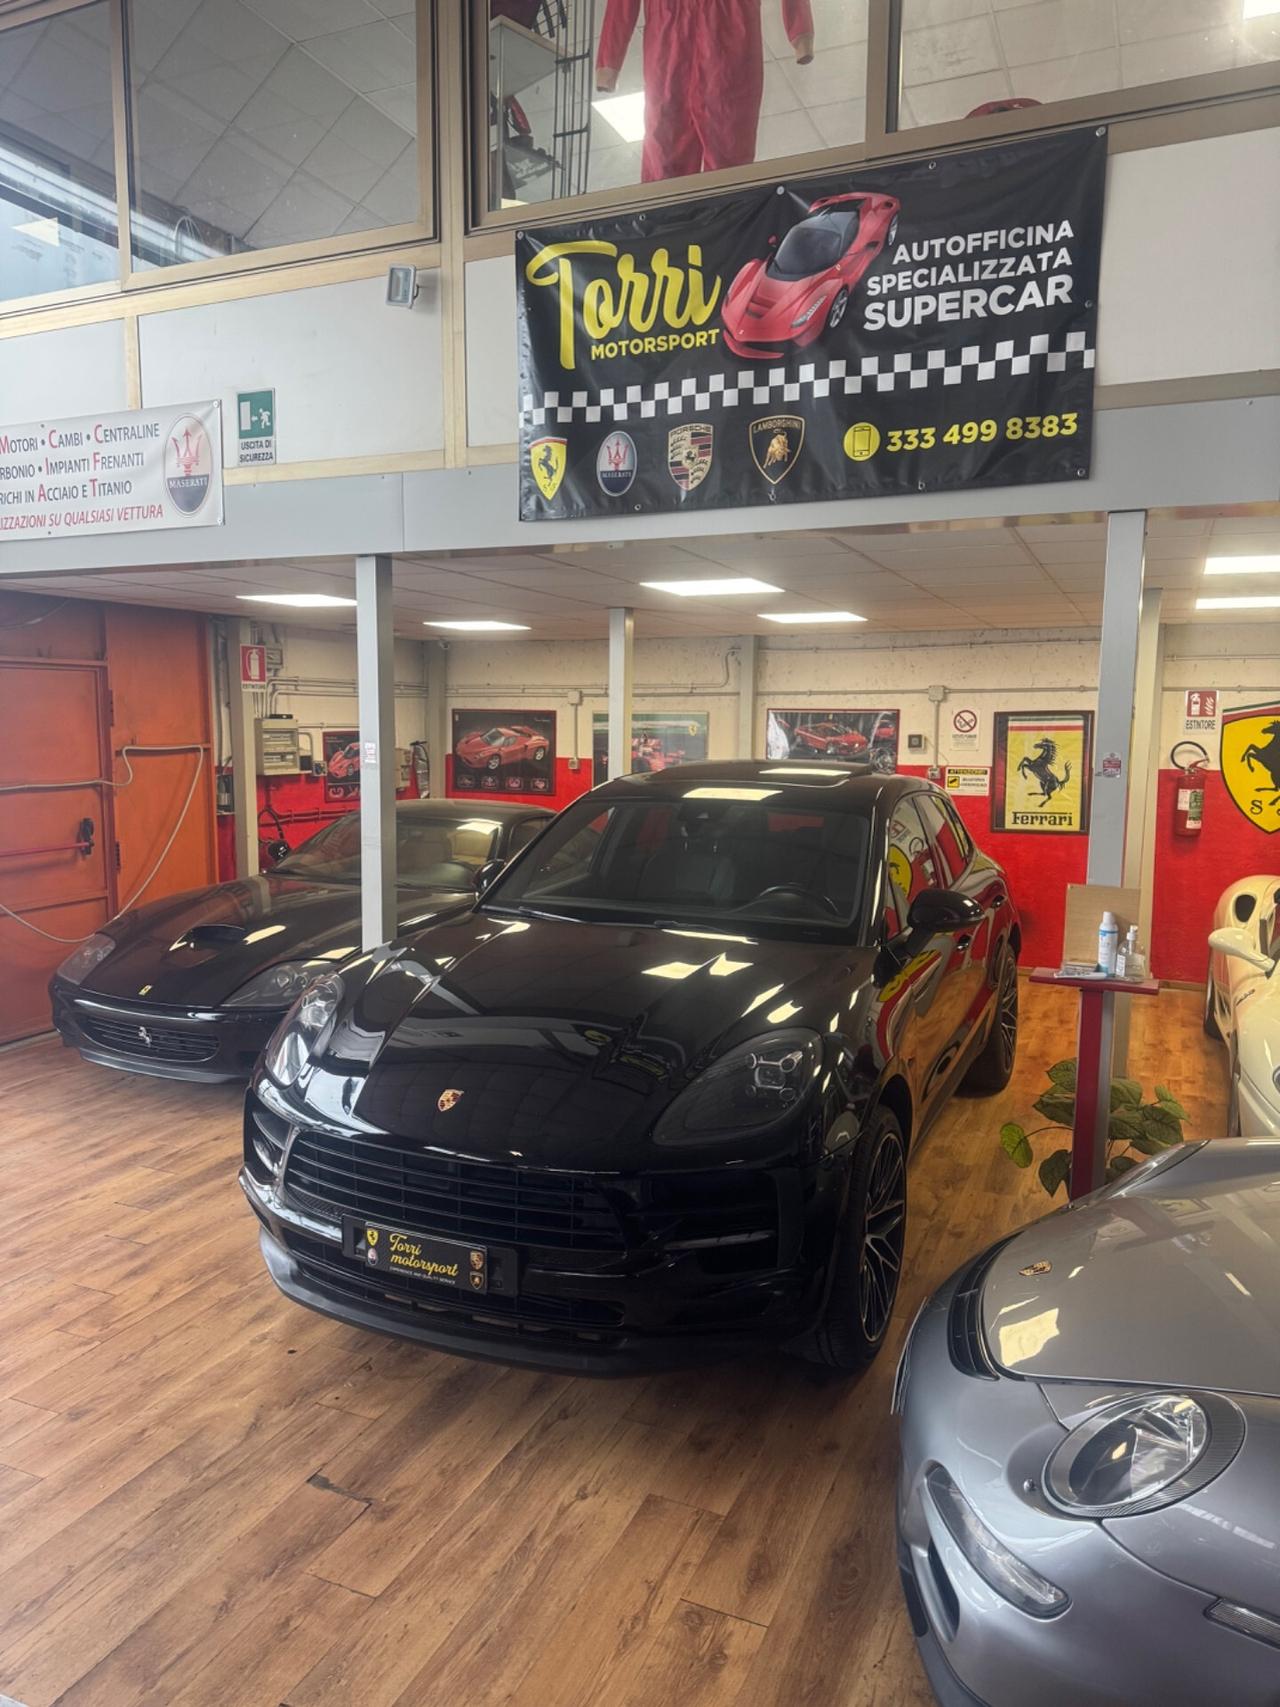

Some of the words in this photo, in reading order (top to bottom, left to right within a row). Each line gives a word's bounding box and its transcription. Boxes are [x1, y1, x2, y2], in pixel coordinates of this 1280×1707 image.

[892, 220, 1075, 265] AUTOFFICINA
[866, 247, 1073, 296] SPECIALIZZATA
[526, 239, 722, 370] Torri
[863, 274, 1074, 331] SUPERCAR
[590, 328, 721, 361] MOTORSPORT
[752, 418, 801, 434] LAMBORGHINI
[886, 427, 937, 452] 333
[942, 419, 998, 445] 499
[1005, 412, 1079, 440] 8383
[0, 434, 39, 454] MOTORI
[48, 429, 84, 449] CAMBI
[94, 423, 160, 444] CENTRALINE
[240, 440, 264, 451] USCITA
[264, 439, 272, 449] DI
[45, 457, 90, 476] IMPIANTI
[93, 452, 144, 471] FRENANTI
[239, 452, 274, 463] SICUREZZA
[25, 490, 35, 503] IN
[38, 484, 79, 502] ACCIAIO
[82, 484, 88, 498] E
[89, 479, 132, 498] TITANIO
[169, 478, 208, 489] MASERATI
[48, 513, 62, 527] SU
[64, 508, 115, 527] QUALSIASI
[117, 504, 164, 521] VETTURA
[1185, 719, 1216, 730] ESTINTORE
[1011, 810, 1073, 826] Ferrari
[389, 1233, 422, 1256] Torri
[390, 1254, 459, 1277] motorsport
